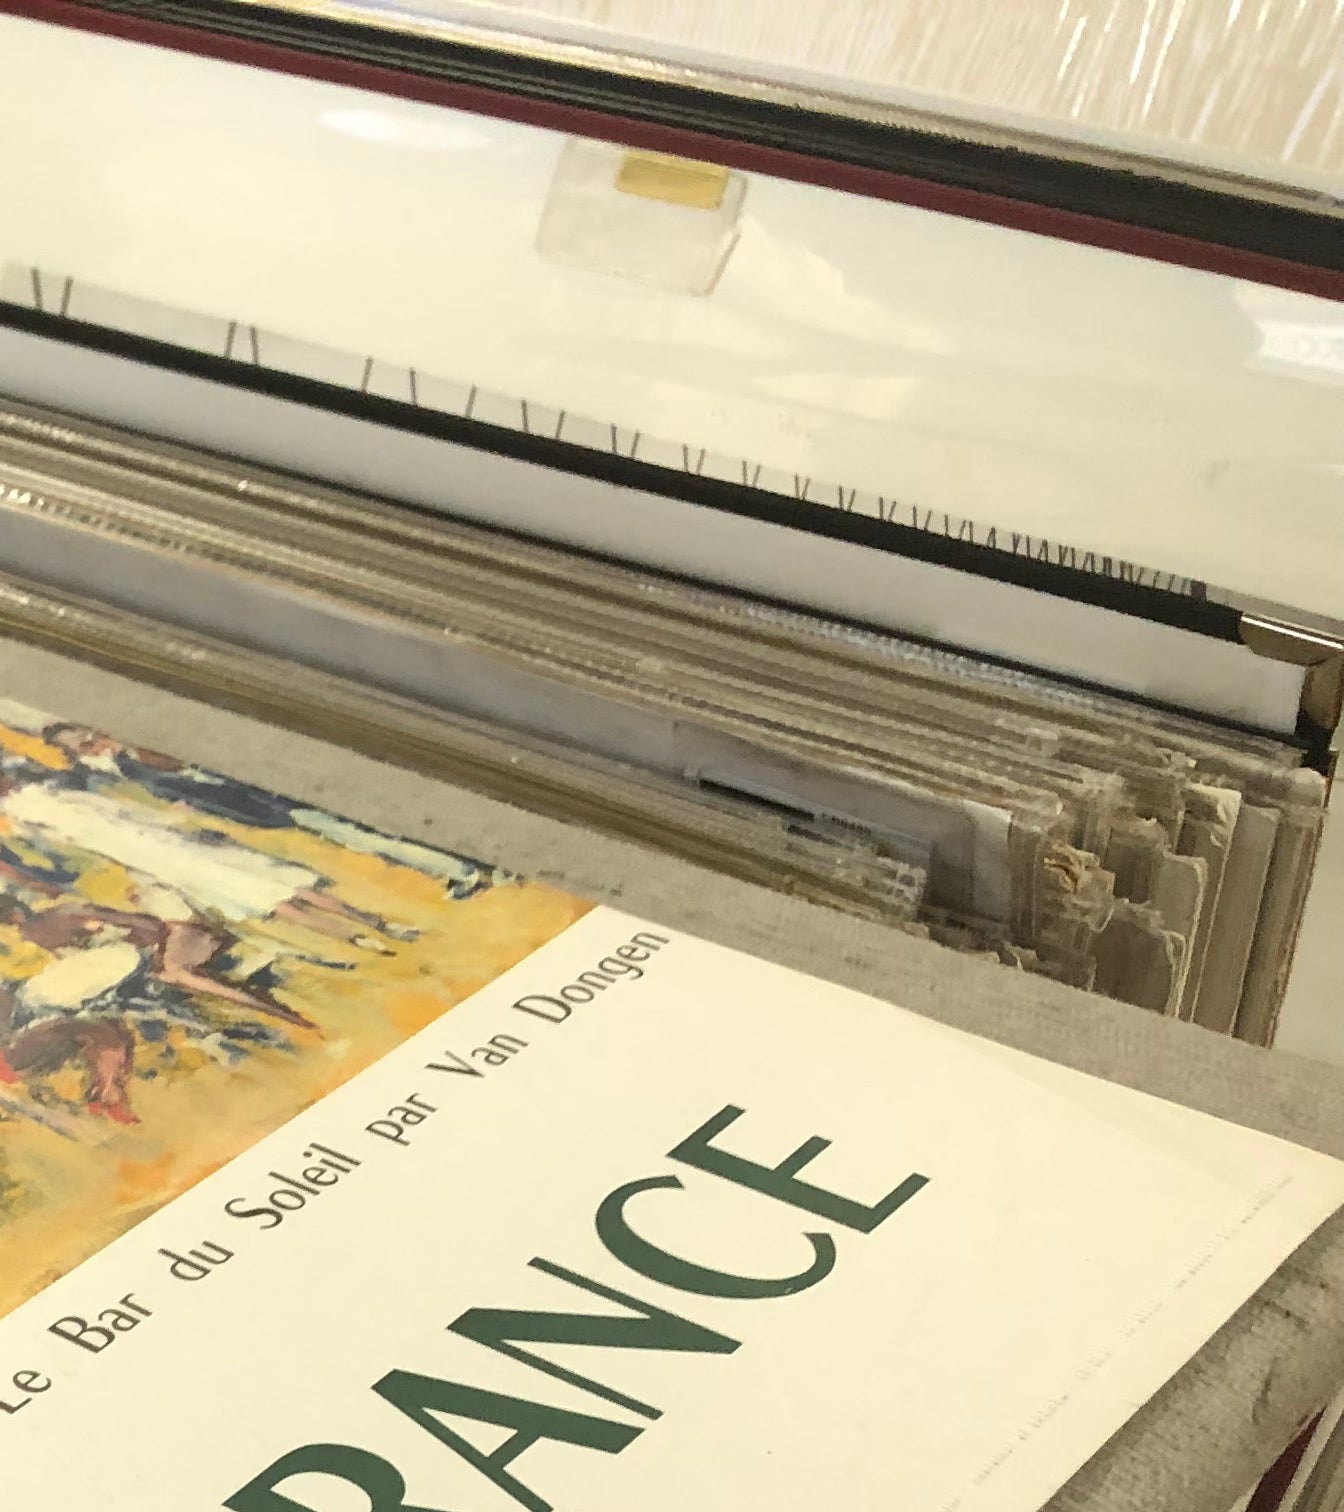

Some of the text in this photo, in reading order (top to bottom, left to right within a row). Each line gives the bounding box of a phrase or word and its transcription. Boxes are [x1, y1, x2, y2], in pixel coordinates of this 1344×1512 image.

[46, 1288, 154, 1356] Bar
[157, 1238, 236, 1284] du
[223, 1141, 362, 1231] Soleil
[364, 1089, 438, 1147] par
[424, 1028, 529, 1079] Van
[511, 930, 670, 1025] Dongen
